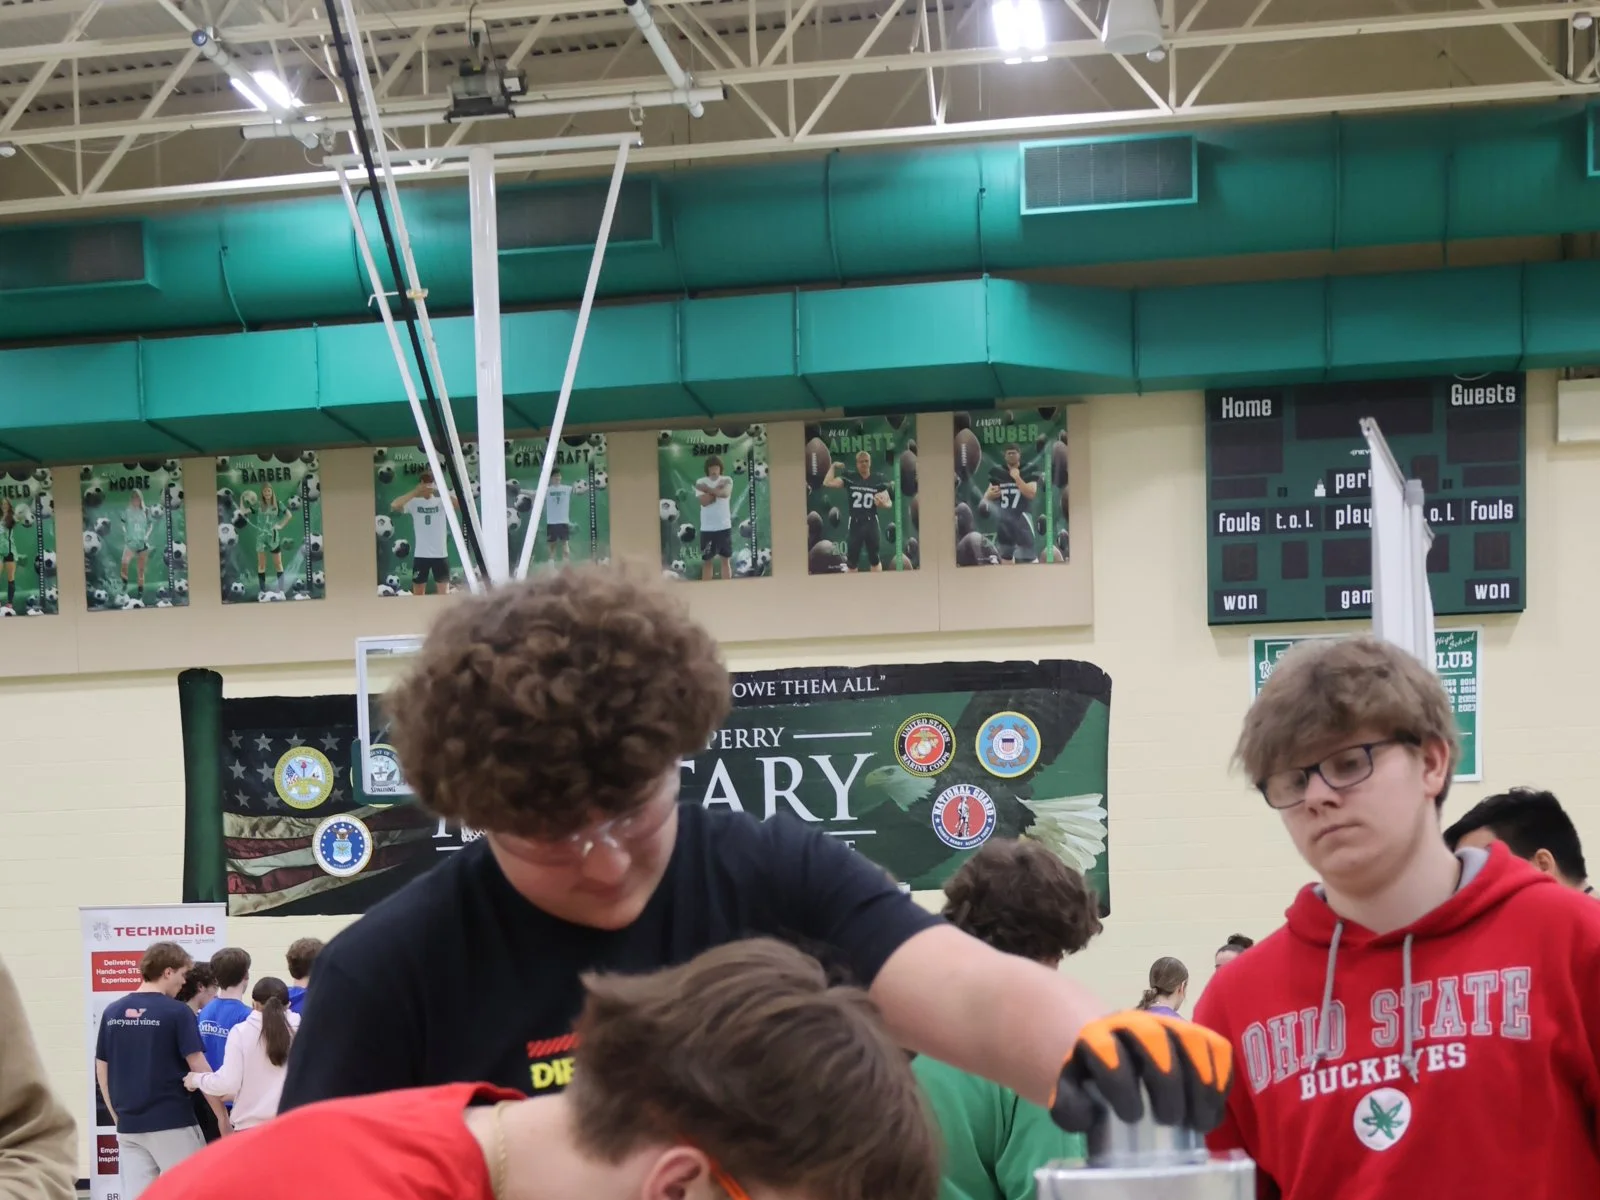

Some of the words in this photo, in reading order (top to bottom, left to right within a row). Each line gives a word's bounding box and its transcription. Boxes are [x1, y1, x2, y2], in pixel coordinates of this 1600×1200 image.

[1451, 383, 1516, 406] Guests
[1221, 397, 1272, 419] Home
[829, 433, 894, 453] ARNETT
[984, 423, 1039, 444] HUBER
[109, 475, 150, 491] MOORE
[242, 467, 291, 484] BARBER
[1336, 469, 1372, 494] peri
[852, 492, 874, 509] 20
[1000, 488, 1021, 509] 57
[1276, 510, 1314, 529] t.o.l.
[1336, 504, 1372, 530] play
[1470, 500, 1514, 521] fouls
[1219, 512, 1261, 533] fouls
[1341, 588, 1374, 613] gam
[1474, 581, 1510, 600] won
[1224, 592, 1258, 612] won
[1436, 651, 1473, 668] LUB
[731, 681, 776, 698] OWE
[780, 679, 838, 695] THEM
[901, 718, 927, 738] UNITED
[928, 718, 951, 742] STATES
[900, 754, 928, 772] MARINE
[929, 751, 950, 771] CORPS
[933, 785, 970, 815] NATIONAL
[973, 785, 994, 815] GUARD
[114, 924, 216, 936] TECHMobile
[104, 959, 136, 967] Delivering
[1242, 1000, 1346, 1095] OHIO
[1371, 966, 1531, 1048] STATE
